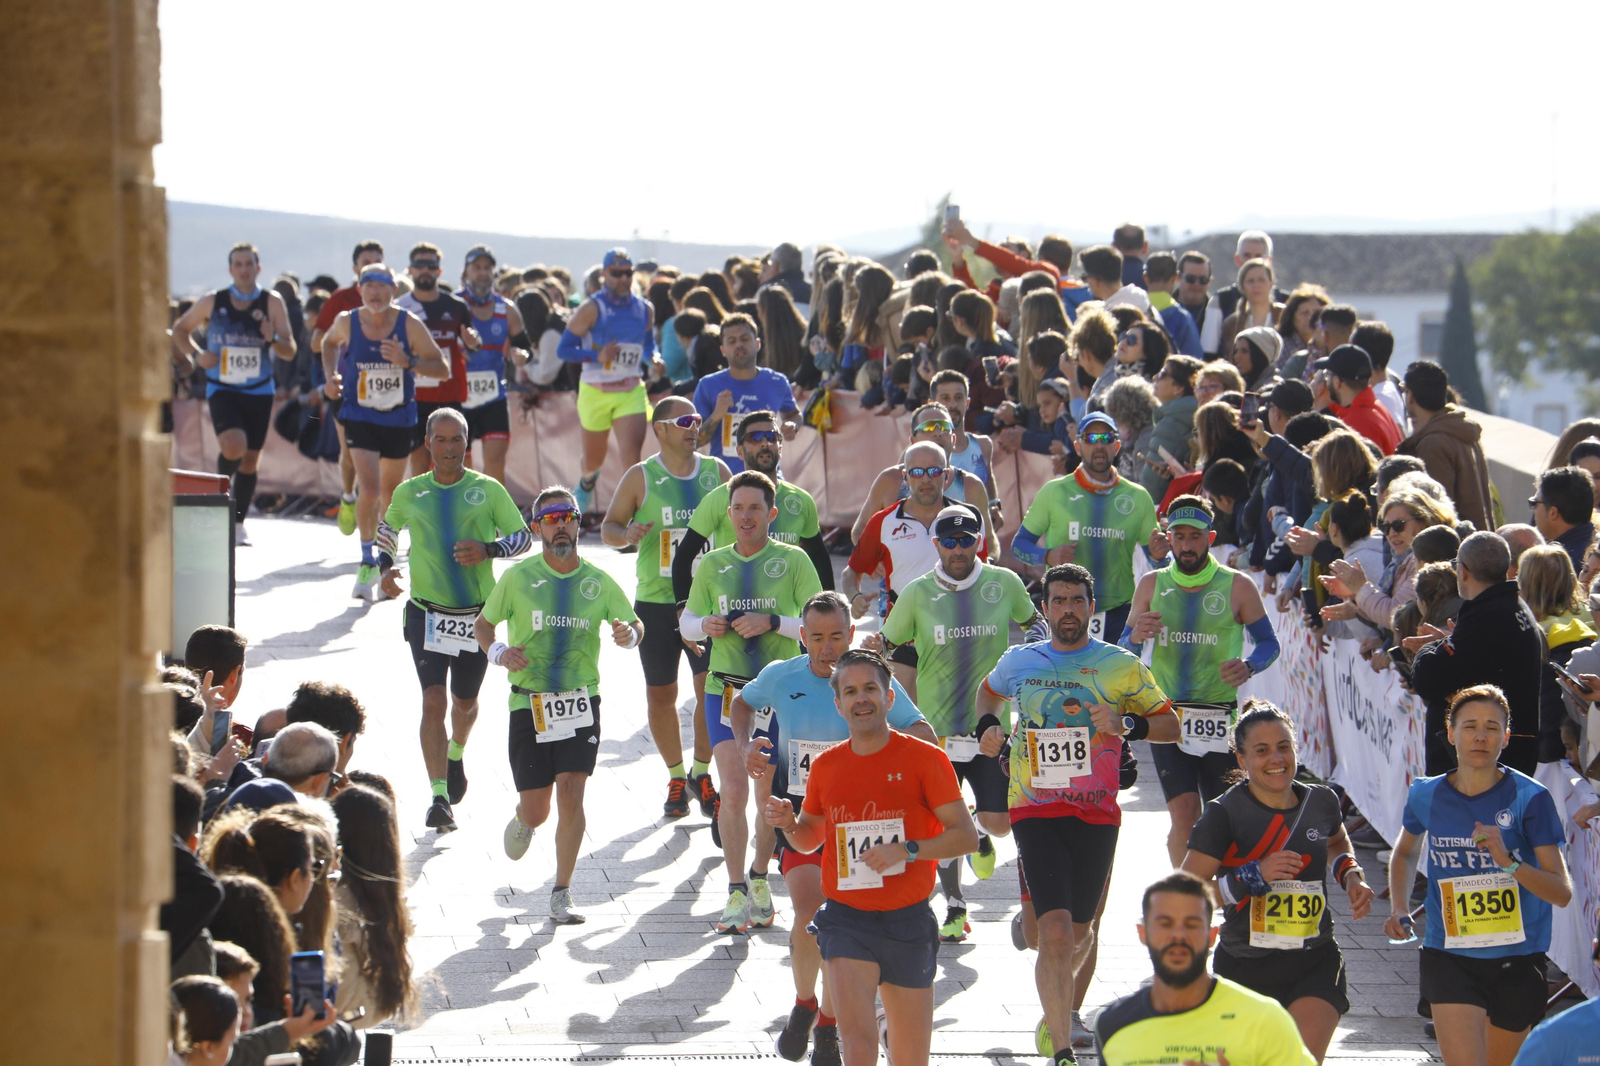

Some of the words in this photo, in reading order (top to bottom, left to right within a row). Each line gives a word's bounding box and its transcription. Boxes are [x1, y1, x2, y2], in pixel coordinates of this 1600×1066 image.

[229, 355, 258, 369] 1635
[367, 377, 400, 391] 1964
[468, 379, 496, 392] 1824
[768, 530, 798, 543] ENTINO
[1081, 525, 1126, 540] COSENTINO
[729, 597, 777, 611] COSENTINO
[436, 618, 476, 640] 4232
[545, 614, 590, 630] COSENTINO
[947, 624, 998, 639] COSENTINO
[1169, 631, 1219, 646] COSENTINO
[1025, 678, 1043, 687] POR
[1044, 680, 1062, 689] LAS
[544, 697, 588, 718] 1976
[1183, 719, 1227, 738] 1895
[1038, 740, 1087, 762] 1318
[829, 804, 857, 825] Mis
[861, 800, 907, 822] Amores
[852, 823, 880, 831] IMDECO
[1461, 878, 1493, 888] IMDECO
[1265, 894, 1322, 919] 2130
[1457, 888, 1516, 917] 1350
[1165, 1045, 1202, 1054] VIRTUAL
